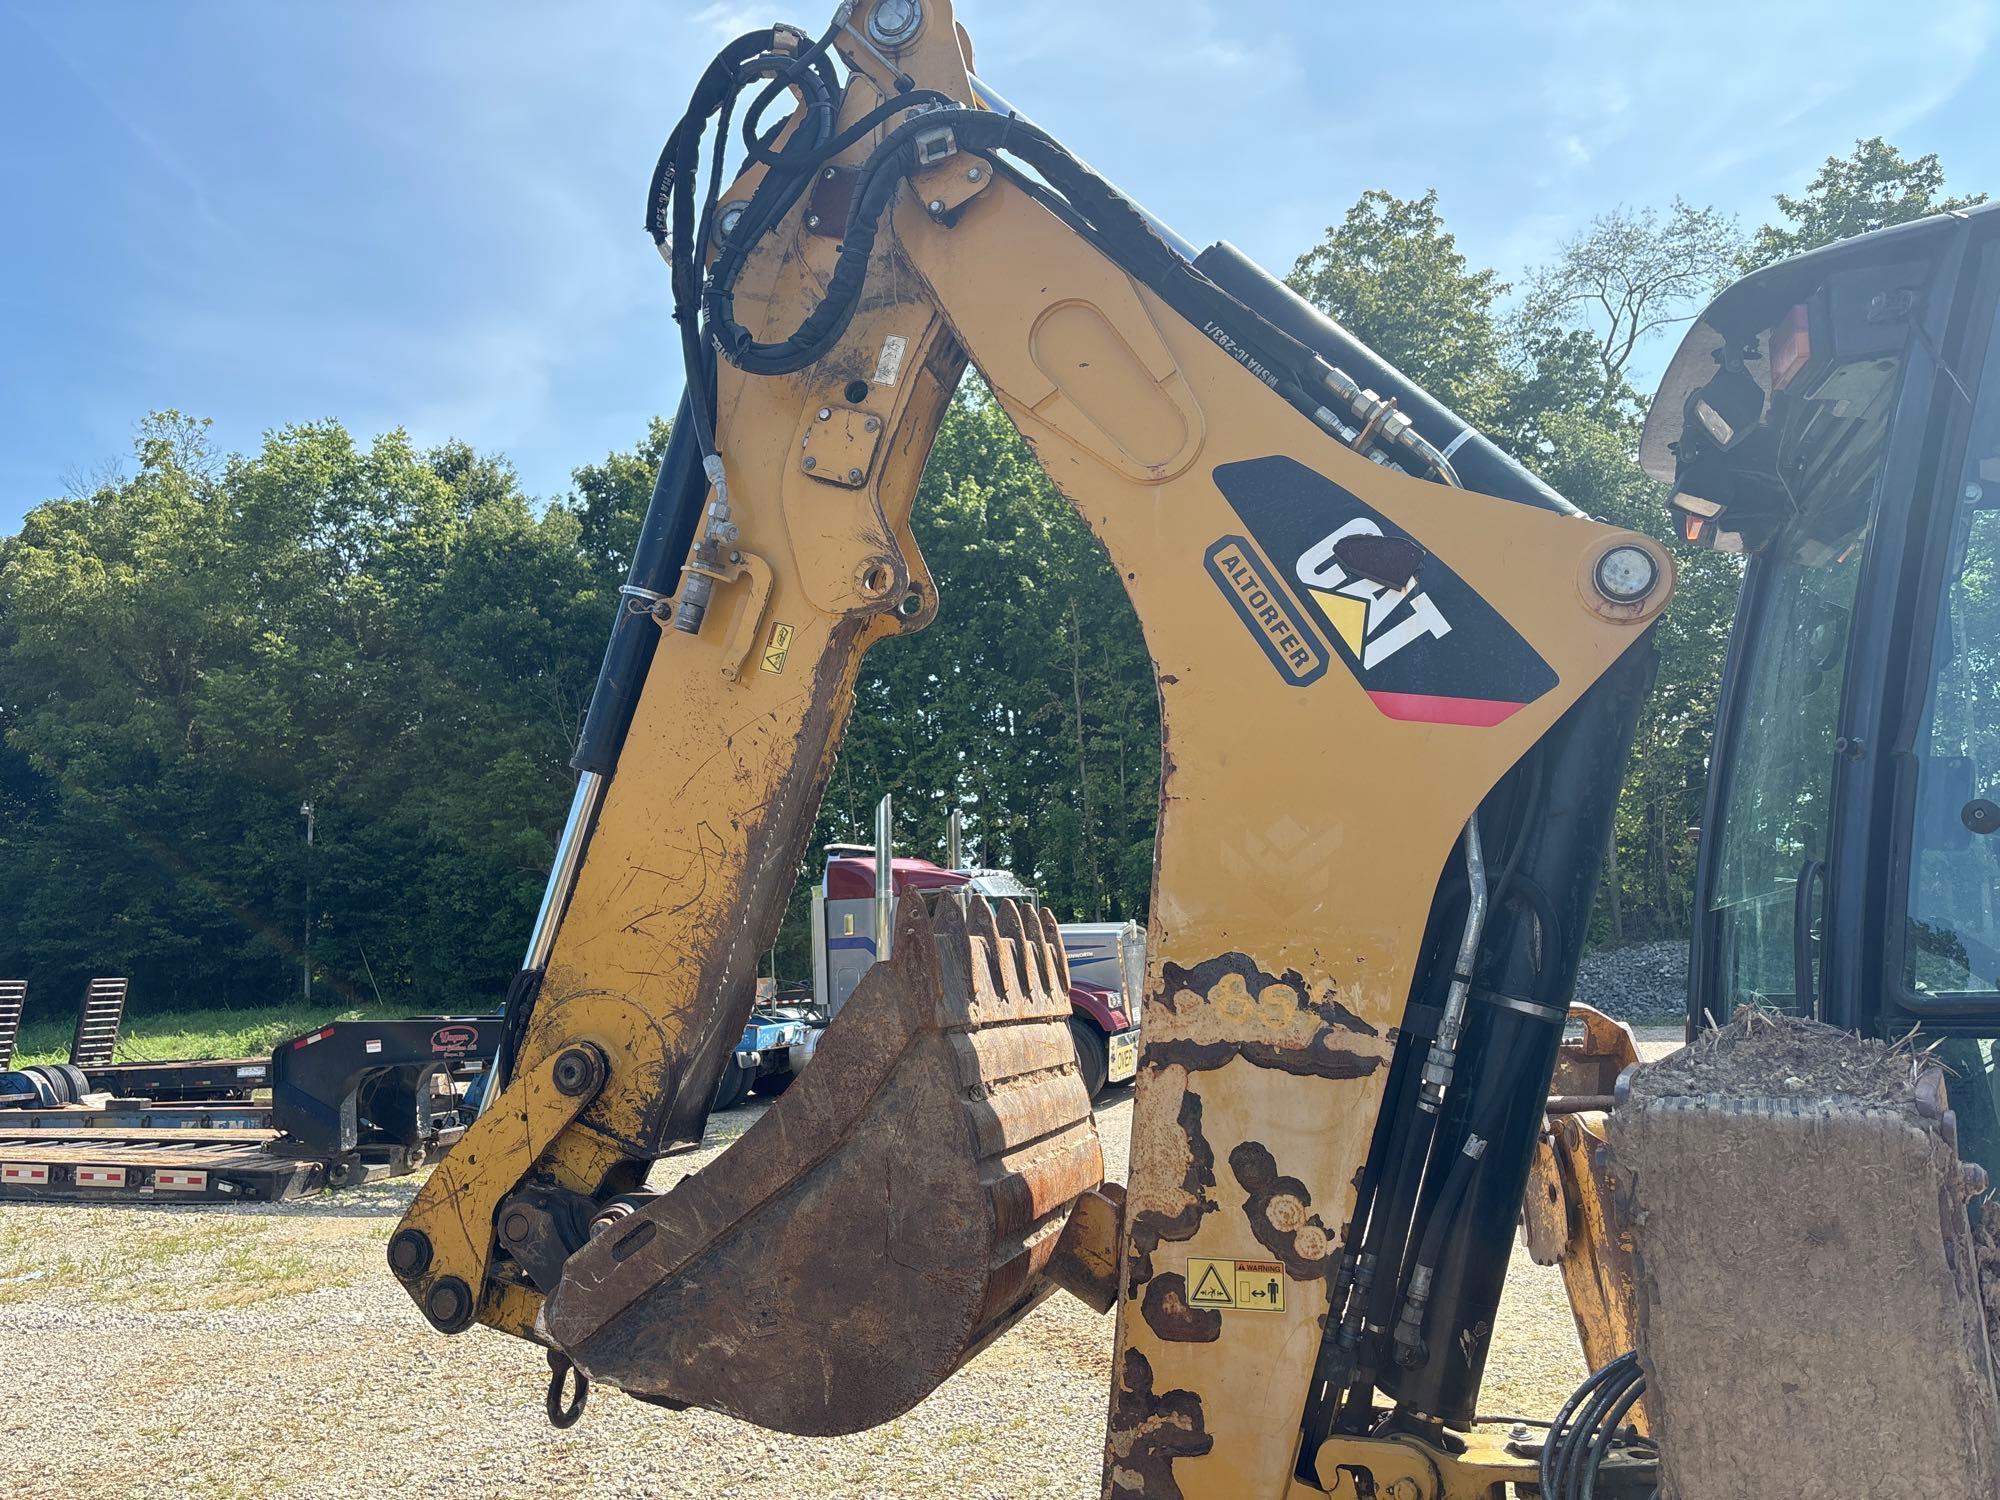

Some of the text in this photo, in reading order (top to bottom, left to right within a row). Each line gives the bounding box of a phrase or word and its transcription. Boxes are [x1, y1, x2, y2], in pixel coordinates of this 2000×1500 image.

[1247, 358, 1279, 388] MSHA
[1221, 554, 1310, 670] ALTORFER
[1295, 517, 1453, 671] CAT
[1246, 1263, 1281, 1273] WARNING
